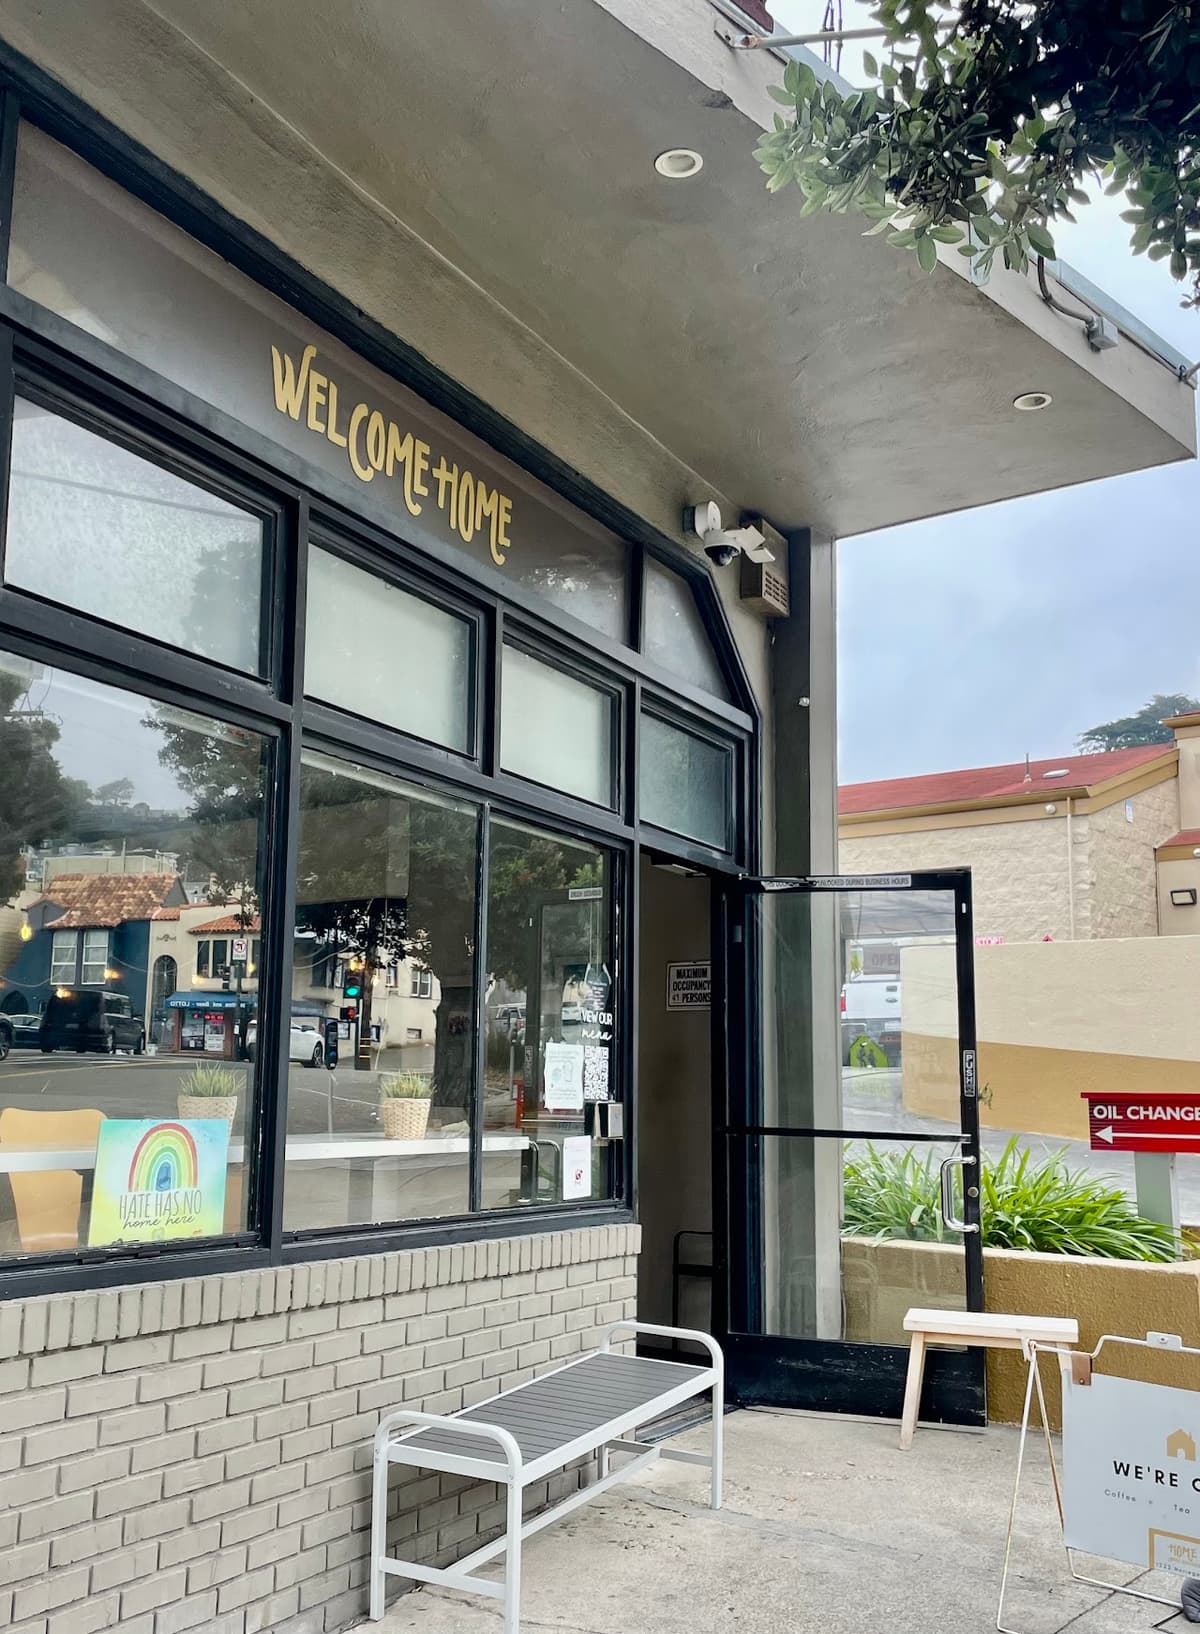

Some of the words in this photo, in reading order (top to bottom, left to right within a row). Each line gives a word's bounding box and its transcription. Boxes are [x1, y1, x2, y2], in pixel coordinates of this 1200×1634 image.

[271, 344, 431, 517] WELCOME
[432, 455, 513, 566] HOME
[845, 878, 865, 887] DURING
[865, 877, 890, 886] BUSINESS
[891, 876, 909, 886] HOURS
[676, 967, 708, 979] MAXIMUM
[581, 1010, 600, 1024] VIEW
[599, 1011, 613, 1026] OUR
[966, 1053, 974, 1084] PUSH
[1093, 1105, 1123, 1120] OIL
[1126, 1105, 1200, 1121] CHANGE
[119, 1193, 152, 1220] HATE
[155, 1191, 180, 1218] HAS
[184, 1189, 202, 1216] NO
[122, 1218, 160, 1230] home
[165, 1215, 195, 1226] here
[1113, 1460, 1179, 1488] WE'RE
[1104, 1488, 1137, 1502] Coffee
[1173, 1503, 1190, 1514] Tea
[1168, 1544, 1198, 1562] HOME
